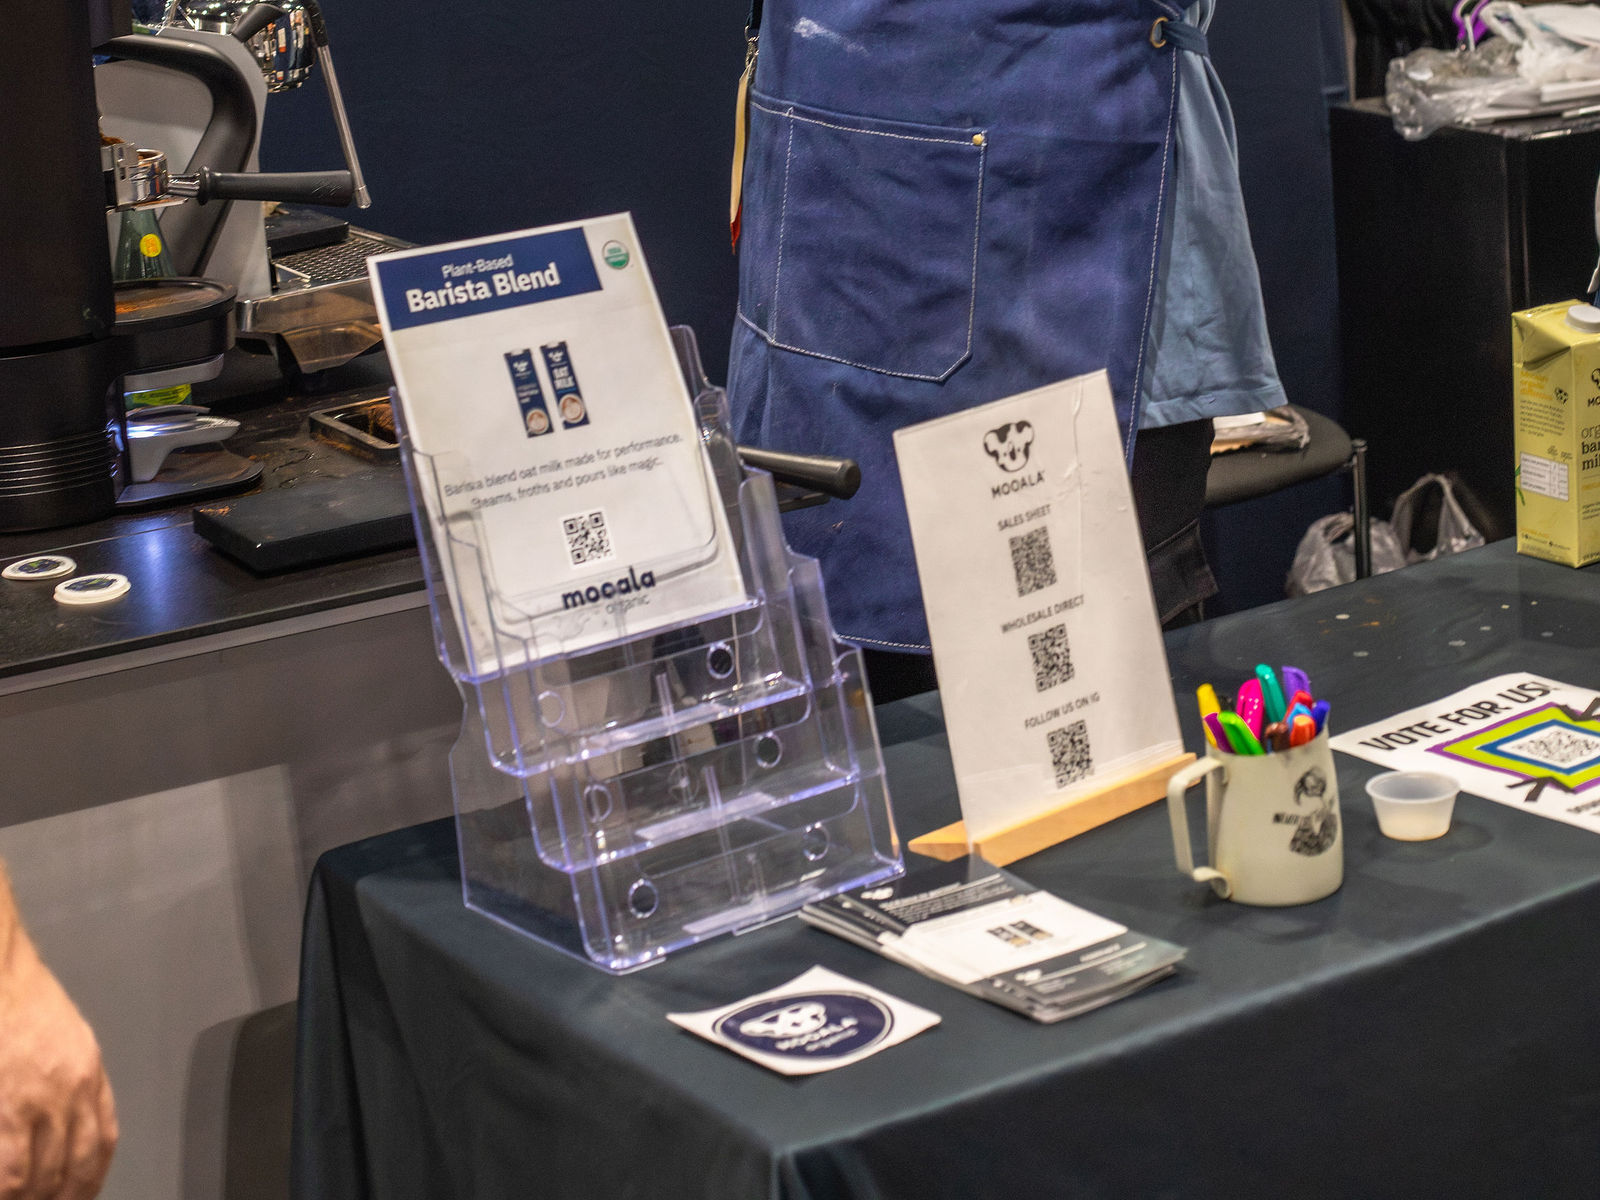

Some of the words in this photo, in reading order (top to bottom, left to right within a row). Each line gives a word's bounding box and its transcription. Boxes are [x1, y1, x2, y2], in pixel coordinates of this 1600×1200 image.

[442, 254, 515, 279] Plant-Based
[406, 281, 492, 313] Barista
[492, 262, 561, 297] Blend
[485, 469, 517, 487] blend
[519, 465, 538, 480] oat
[539, 459, 563, 474] milk
[565, 453, 595, 469] made
[597, 448, 612, 461] for
[614, 432, 684, 458] performance.
[518, 483, 551, 499] froths
[552, 475, 574, 491] and
[575, 469, 606, 486] pours
[607, 461, 627, 477] like
[991, 471, 1045, 499] MOOALA
[998, 513, 1024, 531] SALES
[1025, 504, 1050, 522] SHEET
[561, 565, 656, 609] mooala
[1001, 606, 1053, 634] WHOLESALE
[1053, 594, 1084, 615] DIRECT
[1024, 708, 1060, 729] FOLLOW
[1061, 702, 1074, 715] US
[1075, 697, 1089, 709] ON
[1358, 720, 1451, 751] VOTE
[1438, 700, 1513, 726] FOR
